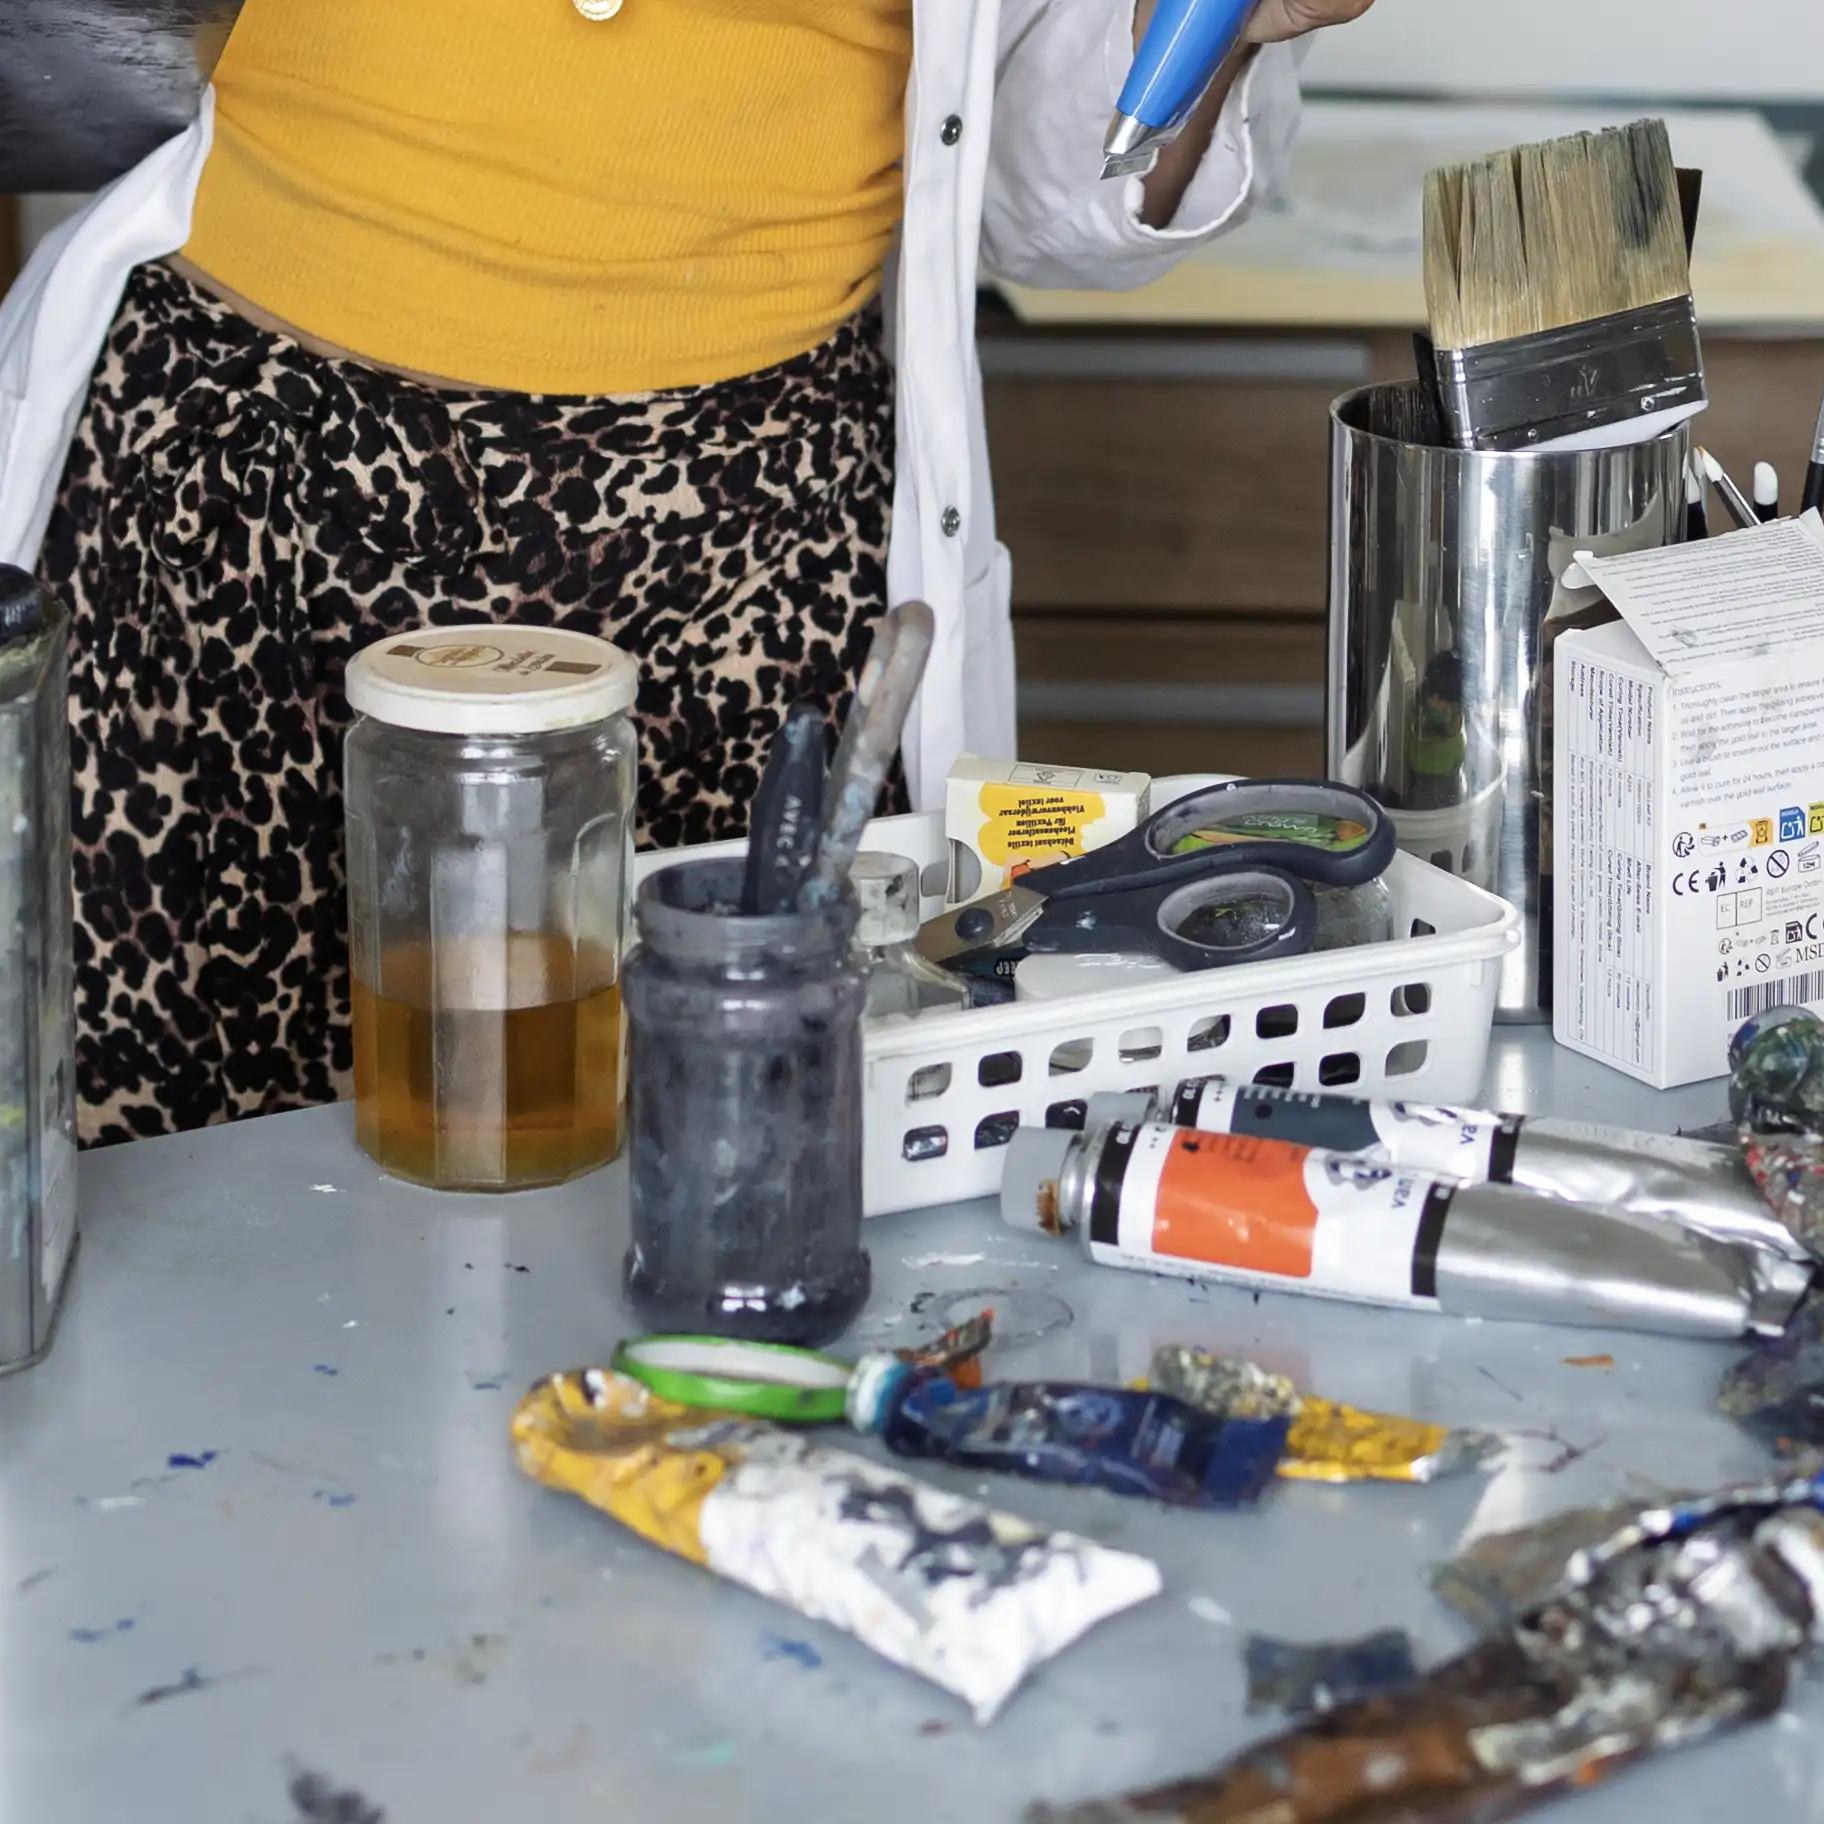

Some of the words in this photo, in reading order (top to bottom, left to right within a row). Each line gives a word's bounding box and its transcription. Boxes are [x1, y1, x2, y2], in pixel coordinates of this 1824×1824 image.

[1673, 681, 1721, 697] Instructions:
[1018, 799, 1043, 808] textiel
[1046, 797, 1064, 805] voor
[1016, 818, 1053, 827] Textilien
[1056, 818, 1066, 826] für
[1008, 840, 1030, 849] textile
[1672, 870, 1699, 896] CE
[1721, 903, 1730, 913] EC
[1739, 898, 1753, 909] REP
